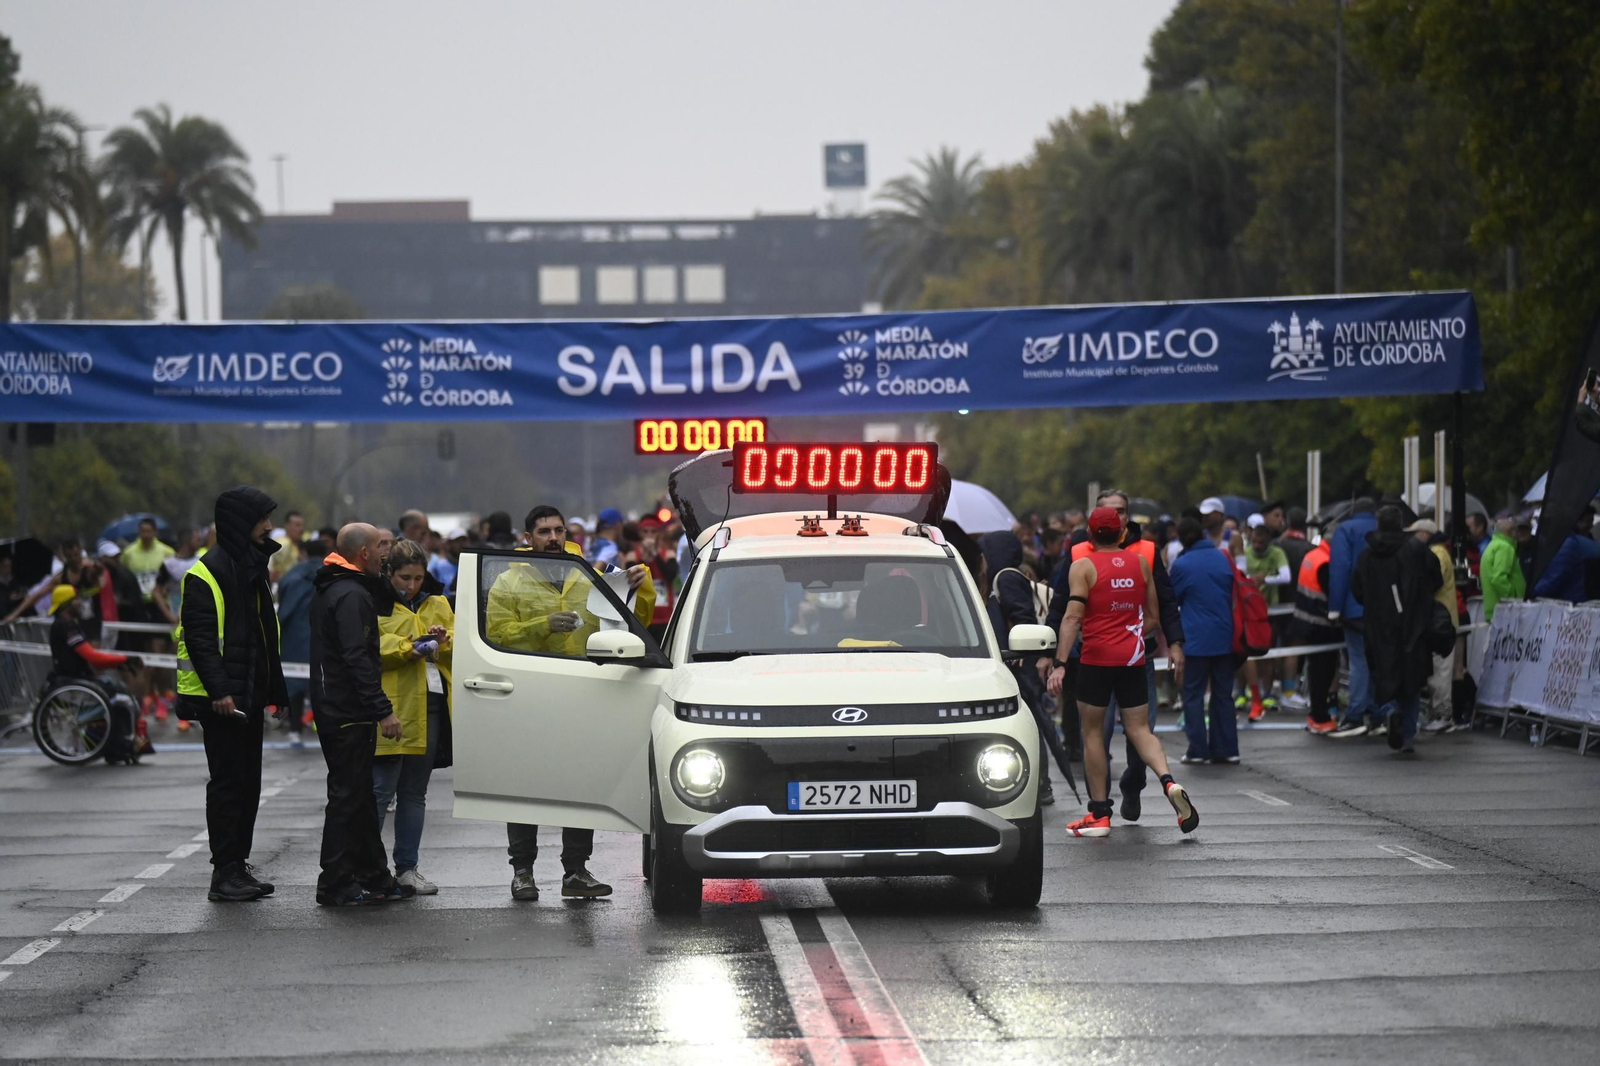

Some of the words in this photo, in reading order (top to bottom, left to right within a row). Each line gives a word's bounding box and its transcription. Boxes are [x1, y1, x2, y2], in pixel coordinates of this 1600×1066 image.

[875, 326, 933, 343] MEDIA
[1333, 317, 1466, 344] AYUNTAMIENTO
[419, 338, 478, 354] MEDIA
[876, 339, 968, 361] MARATÓN
[1067, 327, 1219, 362] IMDECO
[197, 351, 343, 382] IMDECO
[419, 351, 512, 371] MARATÓN
[1333, 346, 1355, 367] DE
[557, 341, 801, 396] SALIDA
[843, 362, 865, 380] 39
[1066, 367, 1113, 378] Municipal
[1115, 364, 1127, 376] de
[1131, 363, 1174, 377] Deportes
[387, 372, 409, 390] 39
[876, 375, 970, 396] CÓRDOBA
[419, 387, 514, 407] CÓRDOBA
[1111, 578, 1134, 588] UCO
[804, 785, 861, 806] 2572
[869, 784, 911, 805] NHD
